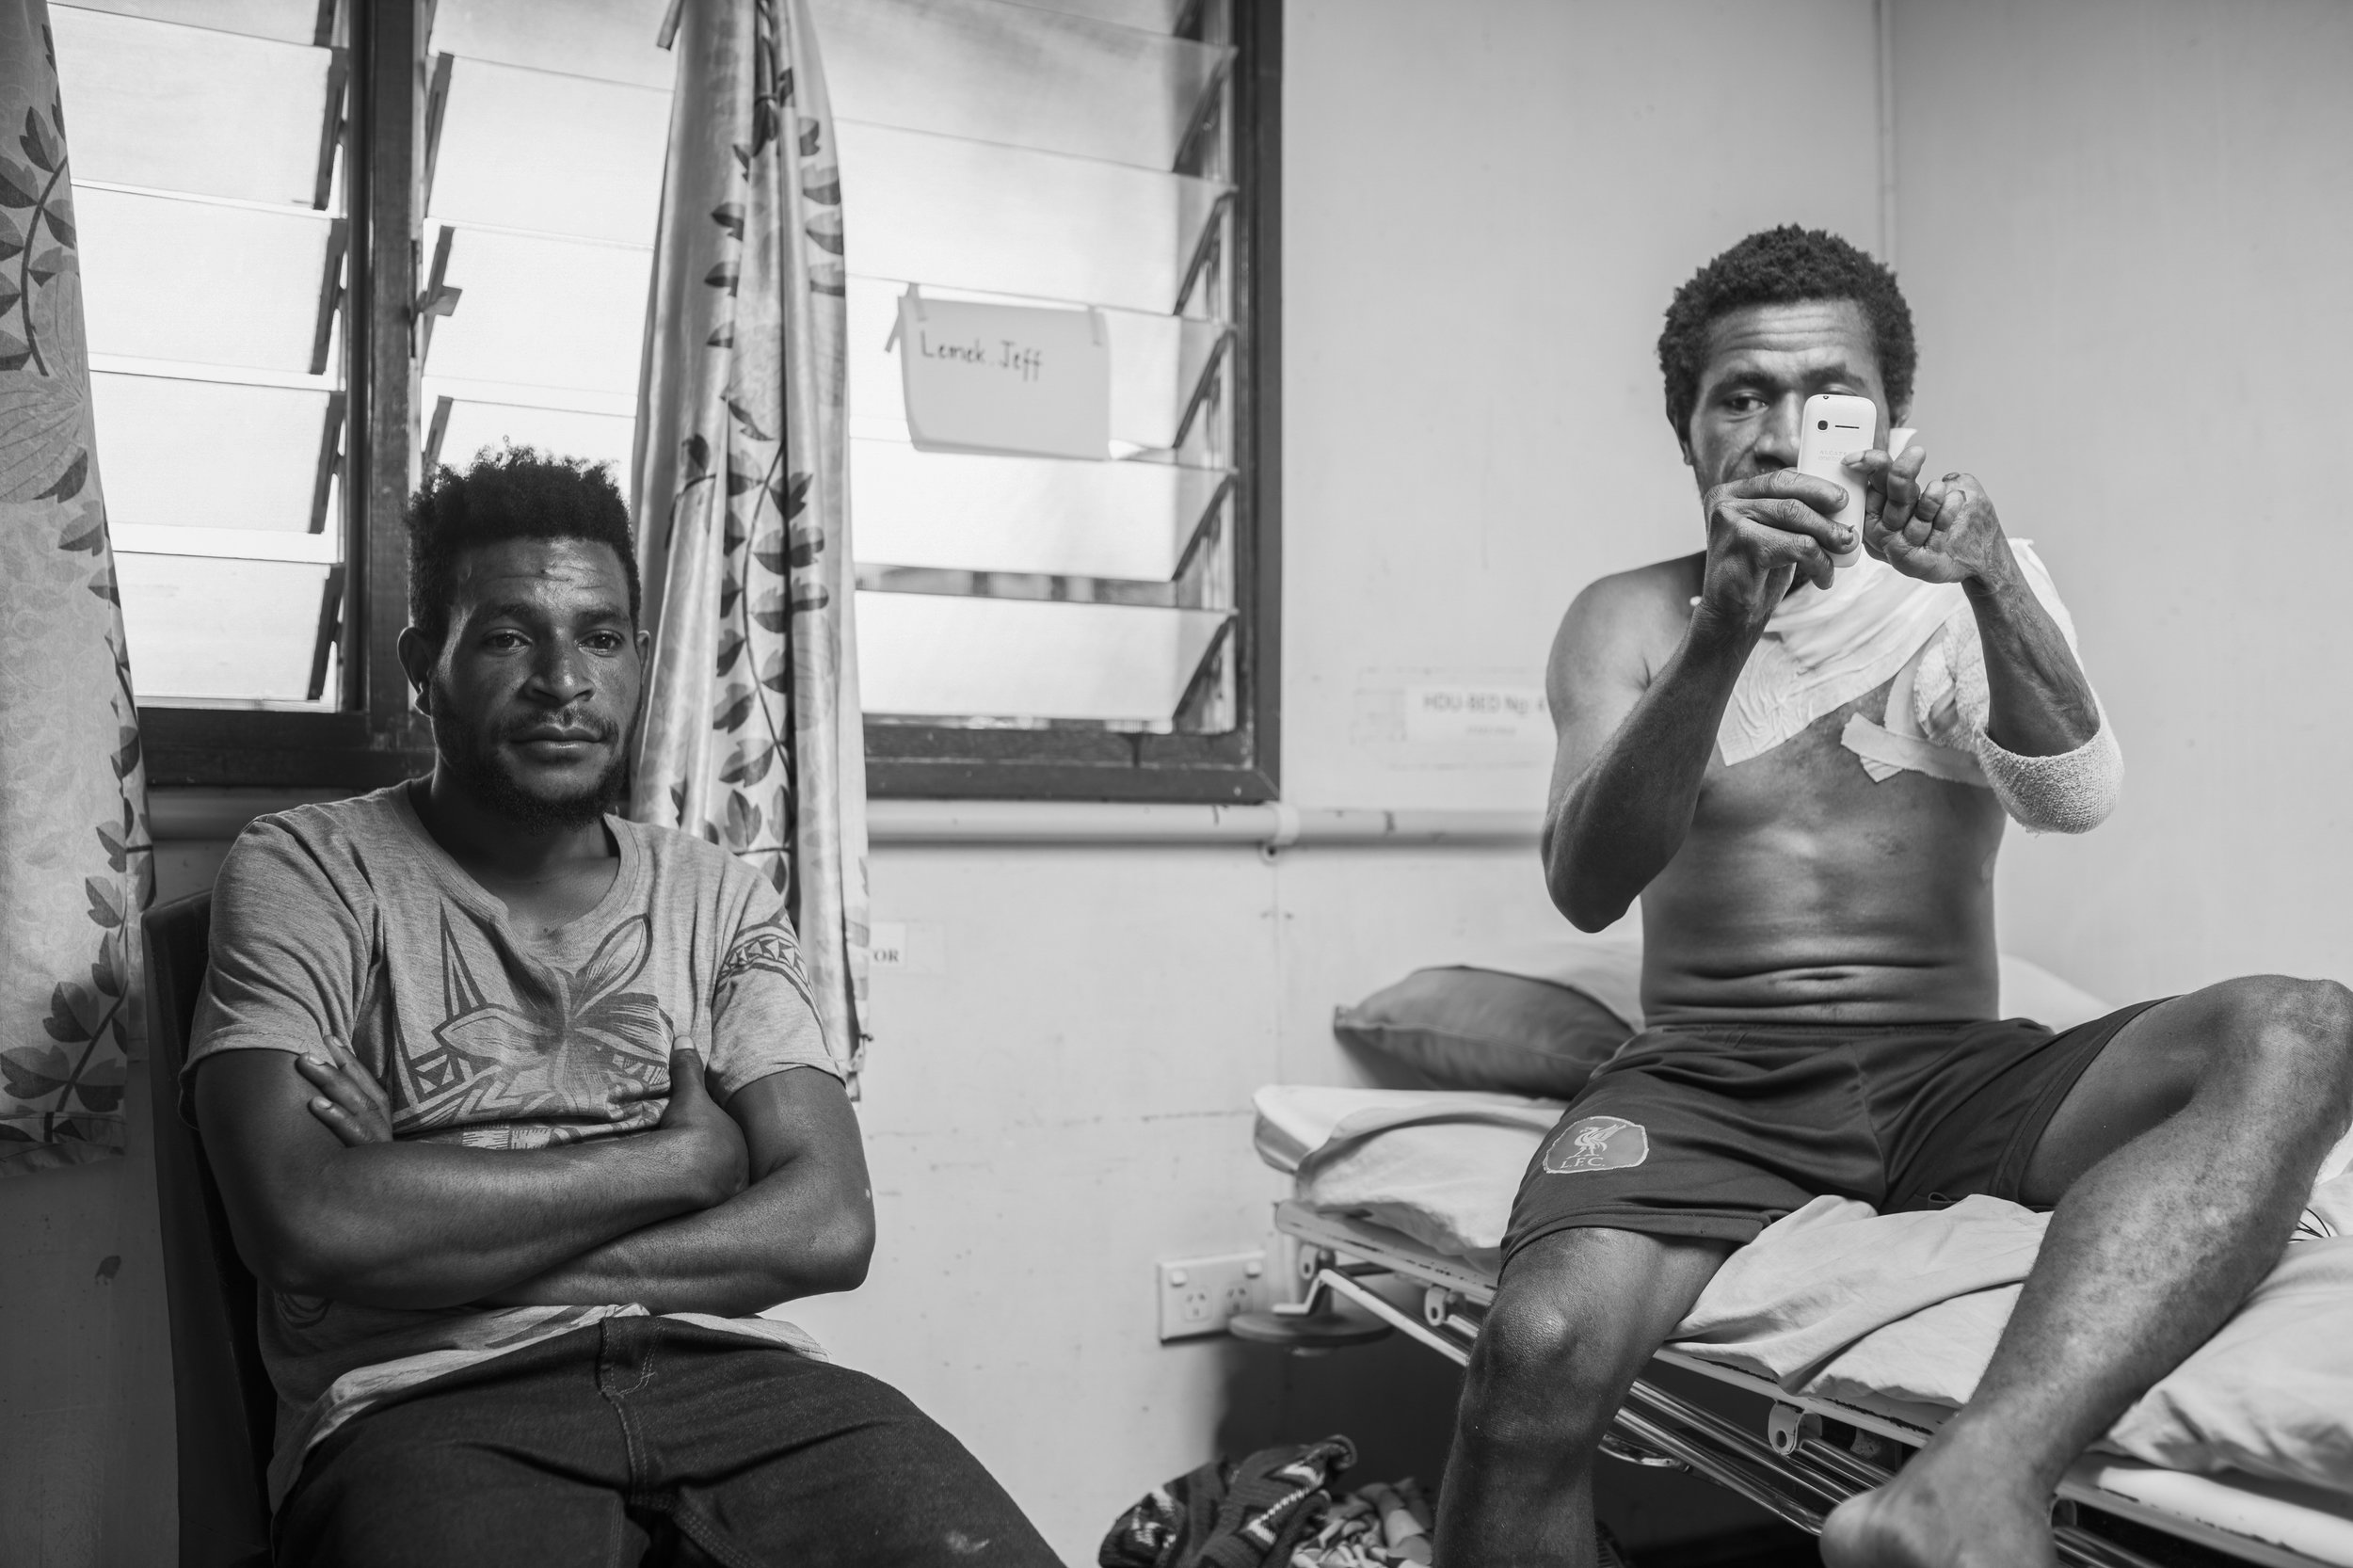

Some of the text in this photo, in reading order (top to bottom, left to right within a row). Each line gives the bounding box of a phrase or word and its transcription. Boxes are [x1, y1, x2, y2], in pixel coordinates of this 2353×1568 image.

[998, 340, 1042, 381] Jeff
[873, 948, 898, 963] OR
[1559, 1157, 1606, 1169] L.F.C.
